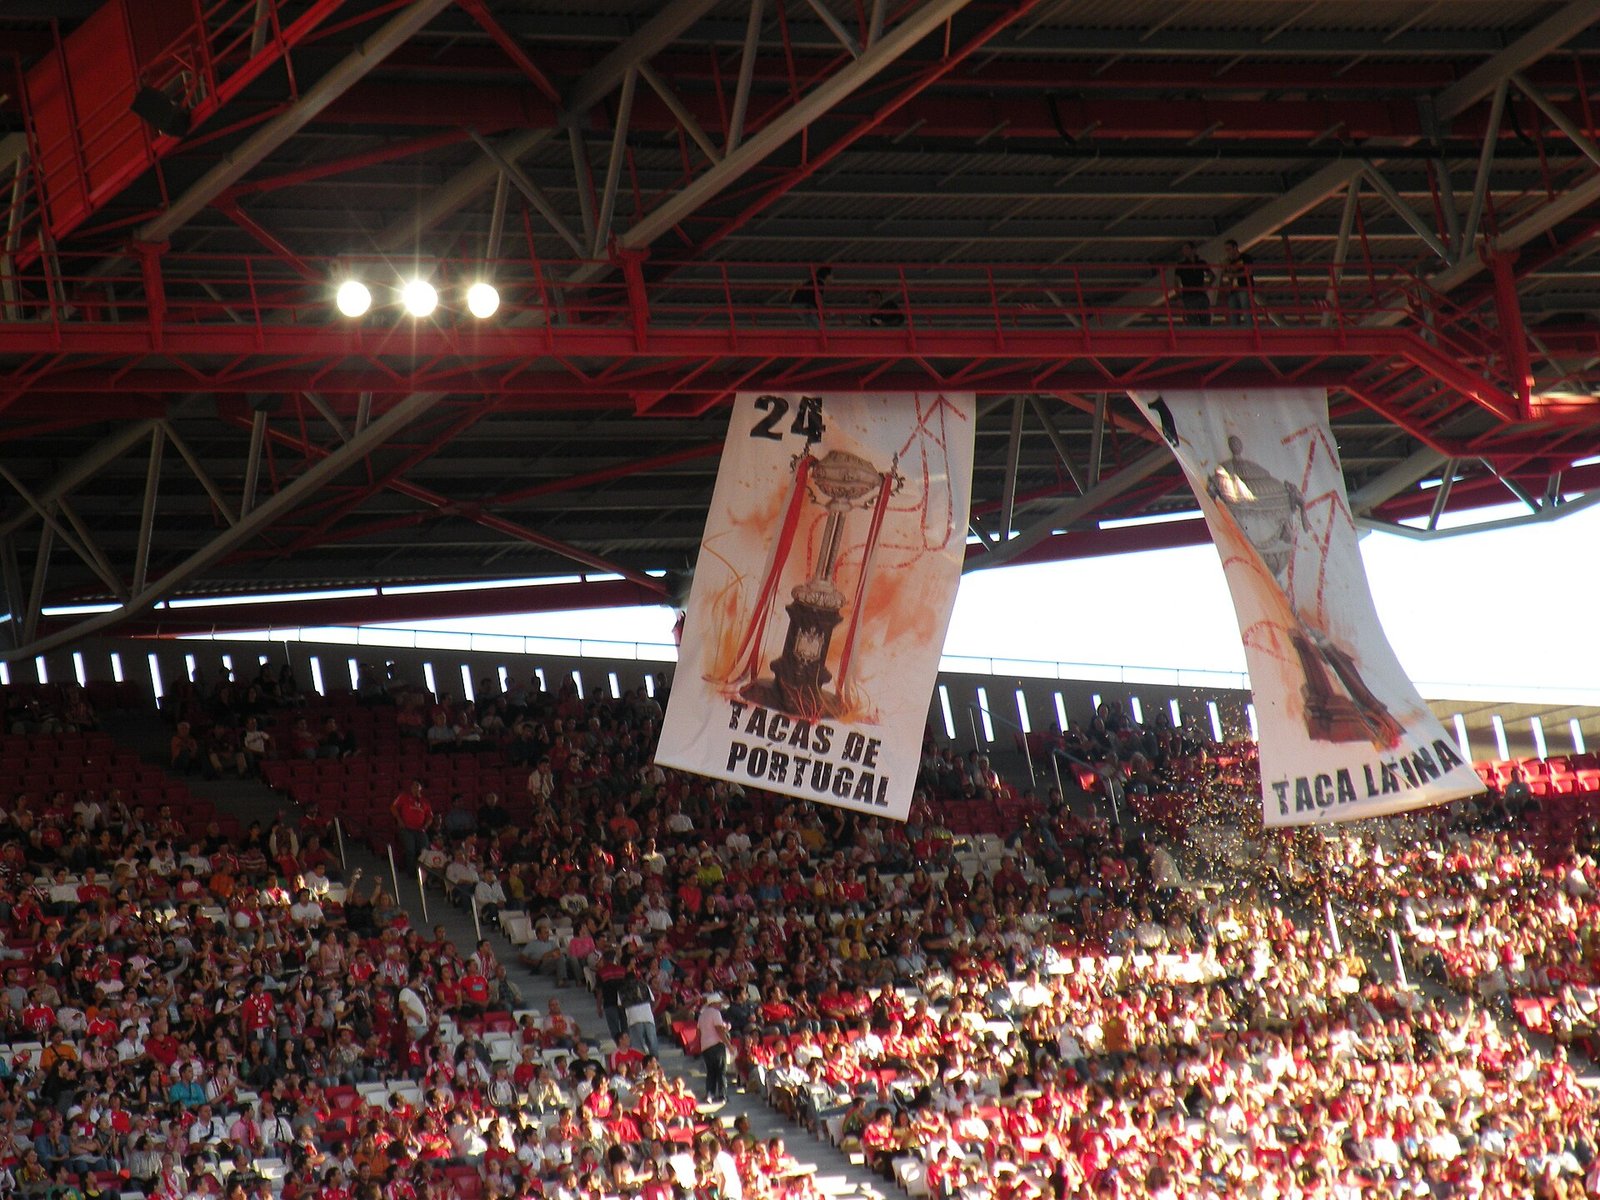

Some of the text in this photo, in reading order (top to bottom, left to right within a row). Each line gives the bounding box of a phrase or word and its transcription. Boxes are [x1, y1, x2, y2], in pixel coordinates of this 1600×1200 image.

[750, 395, 825, 443] 24
[726, 741, 890, 807] PORTUGAL
[841, 732, 881, 768] DE
